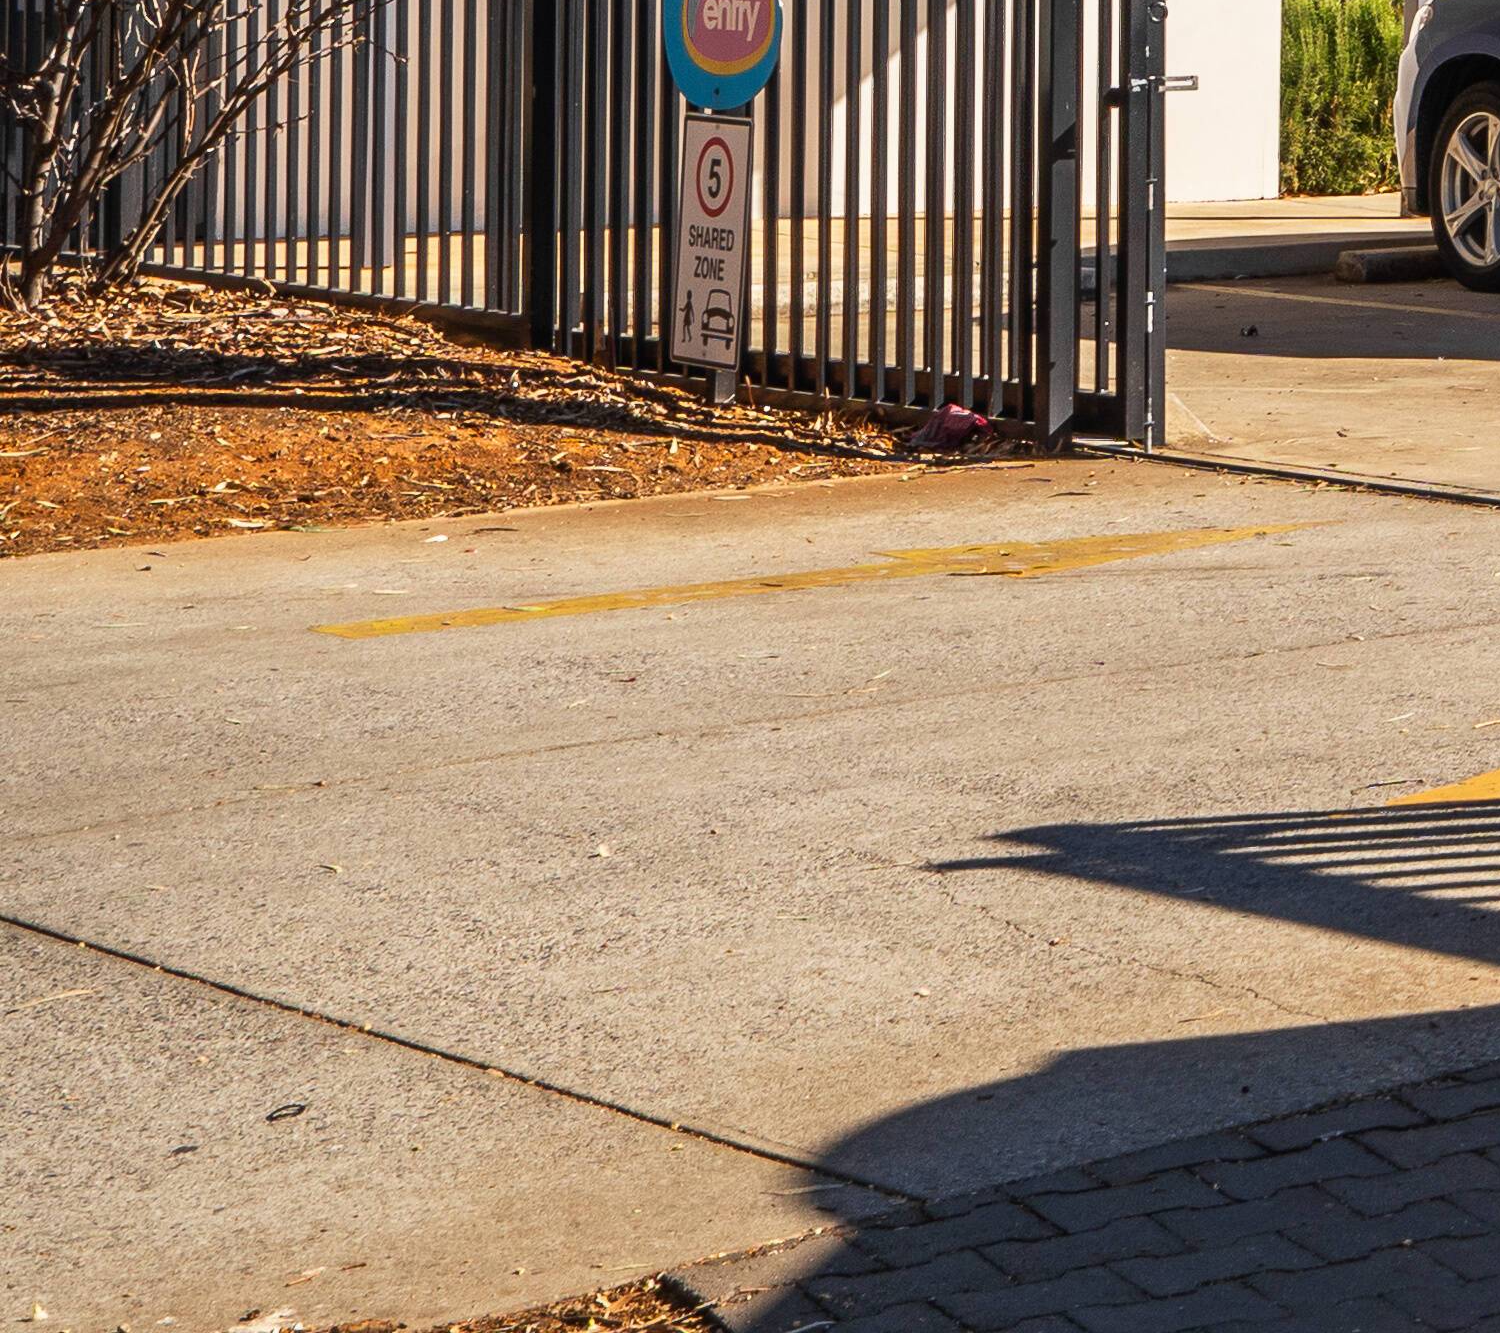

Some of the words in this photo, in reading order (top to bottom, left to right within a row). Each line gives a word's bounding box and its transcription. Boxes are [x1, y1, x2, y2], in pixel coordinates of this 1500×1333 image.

[707, 158, 722, 199] 5
[688, 224, 735, 251] SHARED
[694, 255, 725, 282] ZONE
